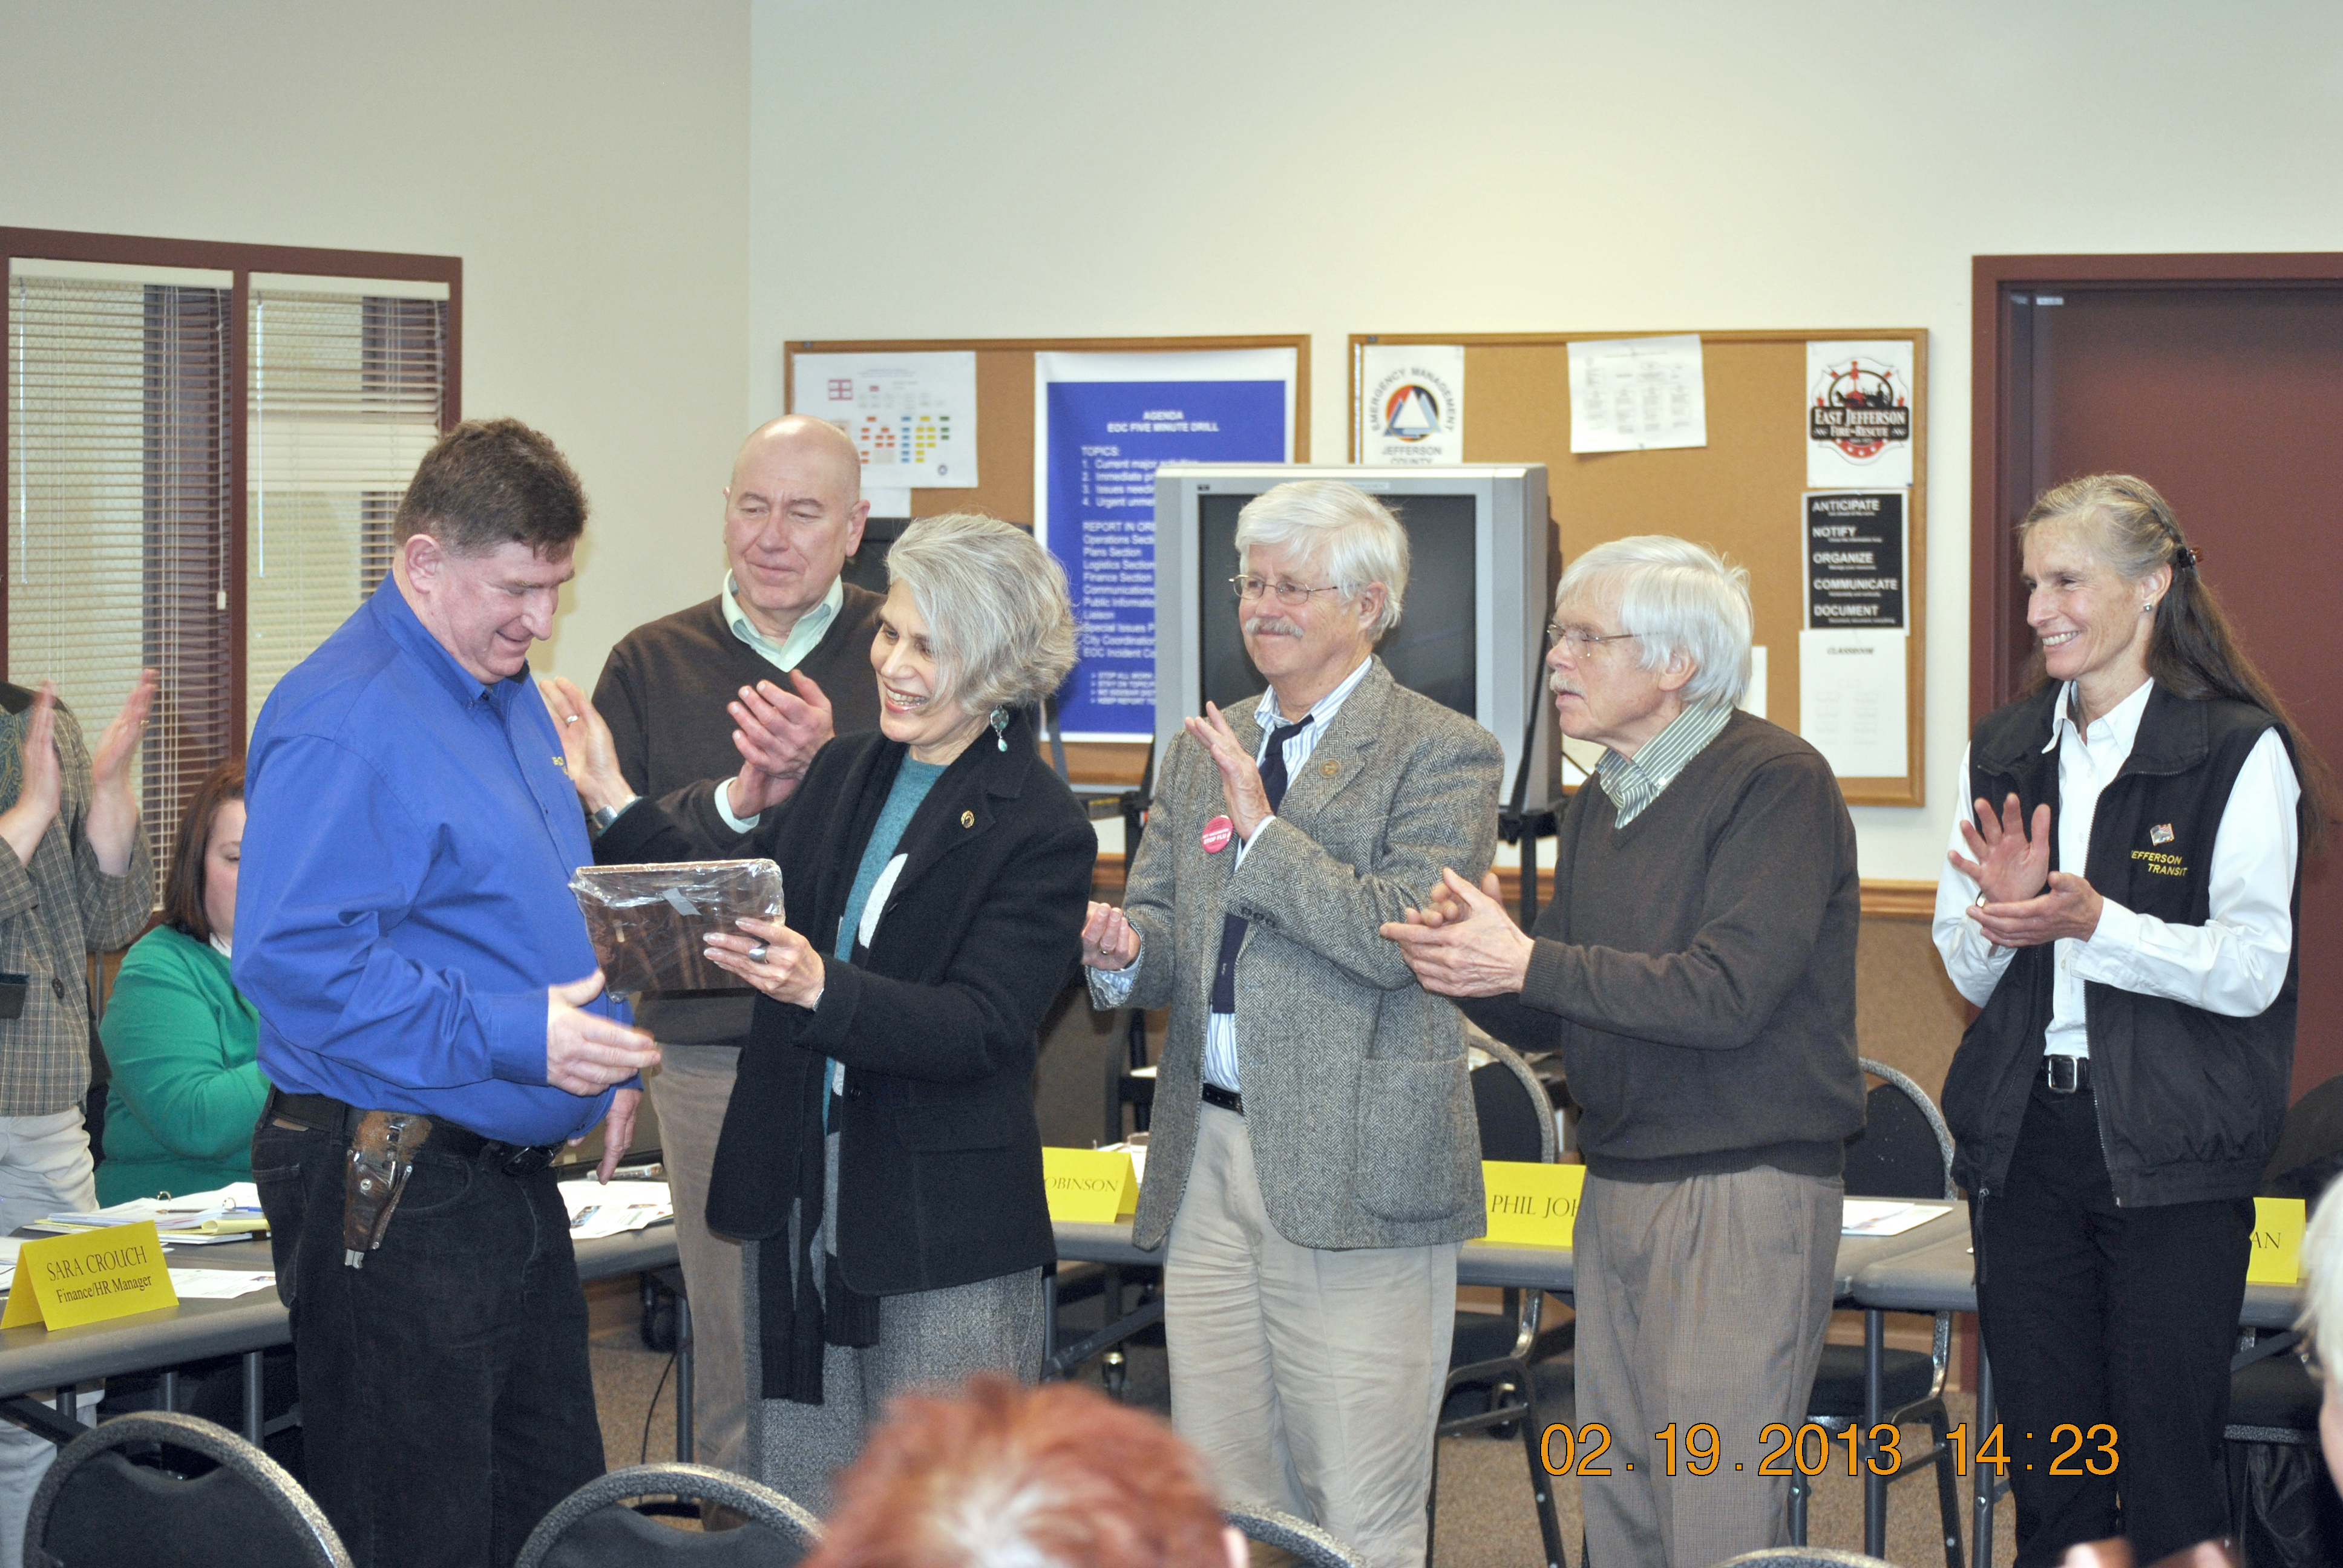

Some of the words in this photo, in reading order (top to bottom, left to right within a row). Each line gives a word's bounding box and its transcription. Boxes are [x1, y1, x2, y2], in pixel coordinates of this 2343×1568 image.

[1369, 368, 1405, 431] EMERGENCY
[1411, 368, 1455, 430] MANAGEMENT
[1142, 410, 1184, 421] AGENDA
[1815, 408, 1843, 425] EAST
[1846, 408, 1906, 426] JEFFERSON
[1107, 422, 1128, 433] EOC
[1130, 422, 1152, 432] FIVE
[1153, 422, 1189, 432] MINUTE
[1191, 422, 1219, 432] DRILL
[1830, 426, 1889, 437] FIRE-RESCUE
[1382, 446, 1442, 456] JEFFERSON
[1095, 459, 1129, 469] Current
[1132, 460, 1157, 471] major
[1095, 471, 1142, 482] Immediate
[1096, 485, 1124, 494] Issues
[1096, 497, 1126, 509] Urgent
[1812, 498, 1880, 512] ANTICIPATE
[1083, 522, 1122, 532] REPORT
[1124, 522, 1135, 532] IN
[1812, 525, 1857, 538] NOTIFY
[1083, 534, 1130, 545] Operations
[1083, 547, 1107, 557] Plans
[1109, 547, 1142, 557] Section
[1812, 552, 1874, 564] ORGANIZE
[1083, 560, 1120, 572] Logistics
[1083, 572, 1118, 582] Finance
[1119, 572, 1152, 583] Section
[1813, 578, 1898, 590] COMMUNICATE
[1083, 597, 1110, 607] Public
[1083, 610, 1115, 620] Liaison
[1814, 604, 1879, 616] DOCUMENT
[1083, 622, 1115, 633] Special
[1118, 623, 1146, 633] Issues
[1083, 635, 1100, 647] City
[1083, 647, 1104, 658] EOC
[1107, 648, 1141, 658] Incident
[1204, 836, 1216, 845] STOP
[2131, 851, 2182, 865] EFFERSON
[2148, 863, 2188, 876] TRANSIT
[1491, 1195, 1536, 1215] PHIL
[47, 1258, 84, 1281] SARA
[86, 1246, 147, 1273] CROUCH
[56, 1281, 112, 1303] Finance/HR
[111, 1275, 152, 1292] Manager
